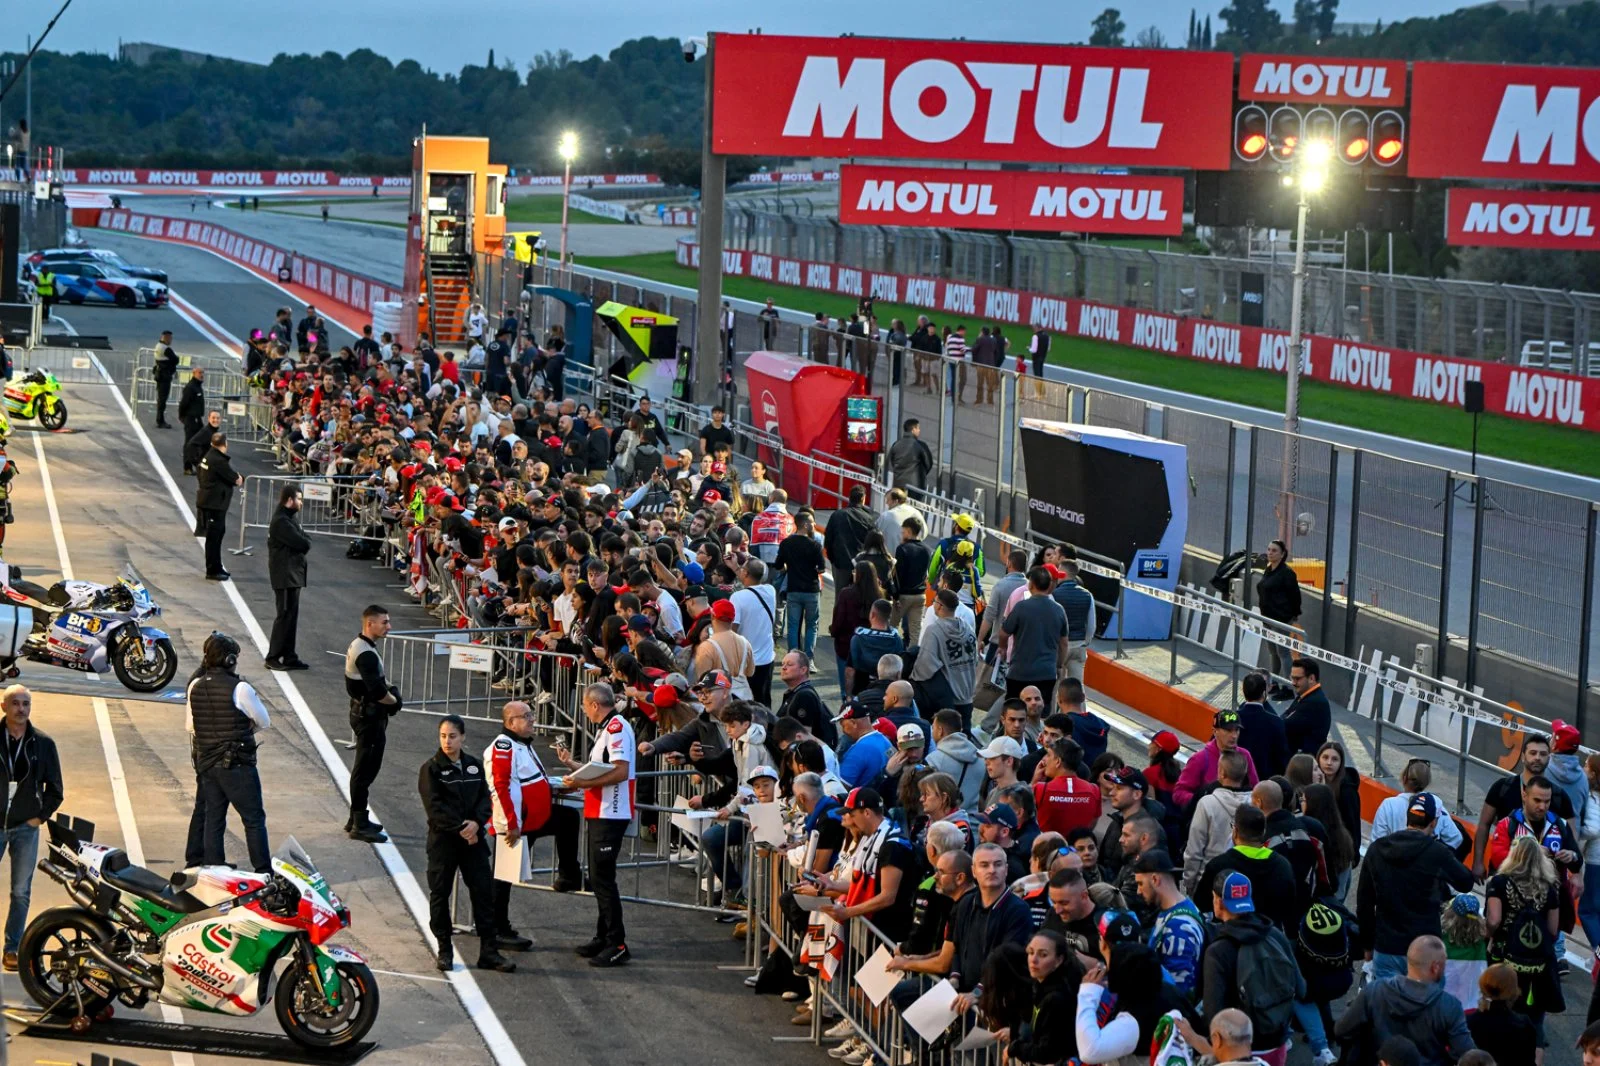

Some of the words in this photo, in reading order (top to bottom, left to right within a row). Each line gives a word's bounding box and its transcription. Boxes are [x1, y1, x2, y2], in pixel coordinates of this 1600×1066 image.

[1254, 62, 1392, 98] MOTUL
[782, 56, 1163, 150] MOTUL
[1482, 84, 1600, 166] M
[88, 170, 137, 183] MOTUL
[148, 171, 199, 184] MOTUL
[211, 171, 263, 185] MOTUL
[275, 171, 328, 185] MOTUL
[339, 177, 372, 186] MOTUL
[382, 177, 411, 186] MOTU
[530, 177, 562, 185] MOTUL
[615, 175, 647, 183] MOTUL
[856, 180, 997, 216] MOTUL
[1030, 186, 1168, 221] MOTUL
[1463, 202, 1596, 237] MOTUL
[807, 264, 831, 290] MOTUL
[837, 268, 863, 296] MOTUL
[905, 278, 936, 307] MOTUL
[944, 283, 975, 314] MOTUL
[984, 289, 1019, 322] MOTUL
[1030, 296, 1068, 331] MOTUL
[1078, 304, 1120, 341] MOTUL
[1132, 313, 1178, 352] MOTUL
[1191, 323, 1242, 364] MOTUL
[1257, 332, 1313, 376] MOTL
[1330, 343, 1392, 391] MOTUL
[1505, 370, 1585, 425] MOTUL
[183, 943, 236, 985] Castrol
[184, 973, 224, 998] HONDA
